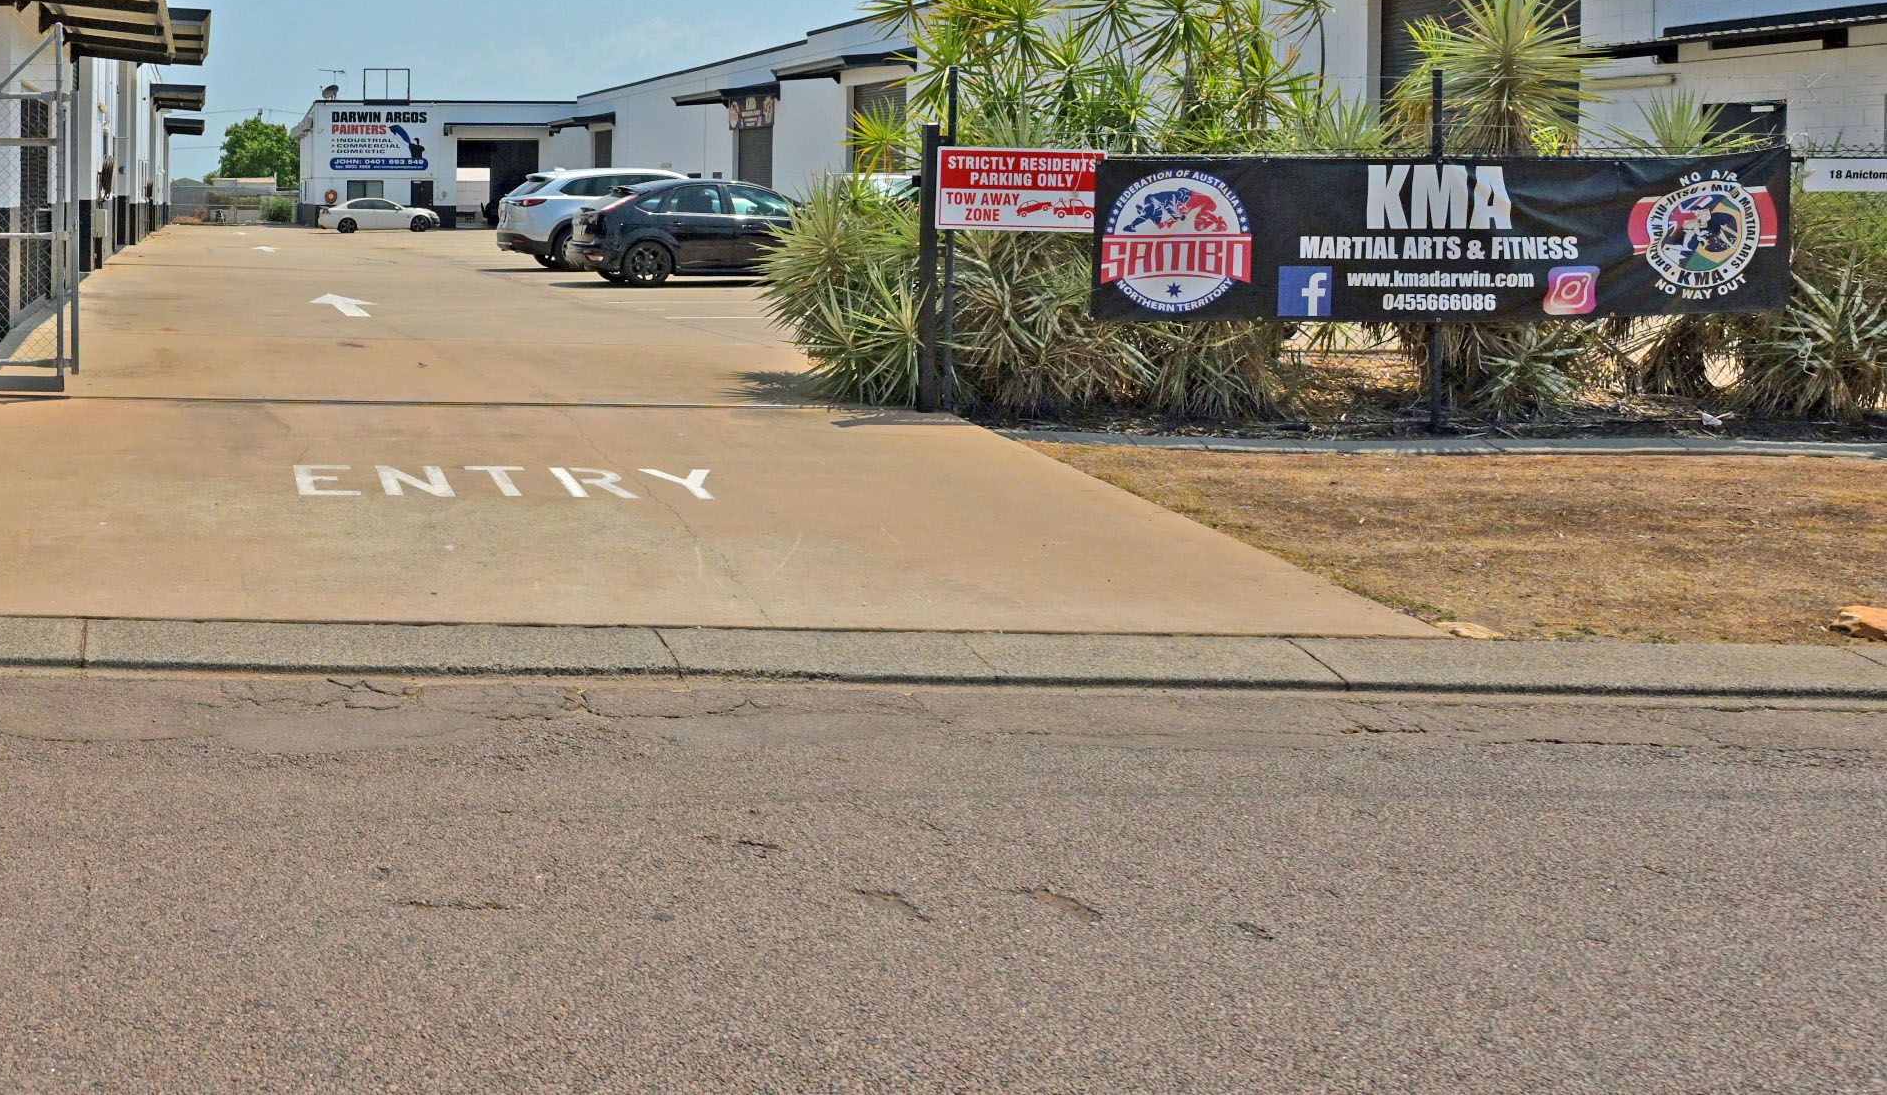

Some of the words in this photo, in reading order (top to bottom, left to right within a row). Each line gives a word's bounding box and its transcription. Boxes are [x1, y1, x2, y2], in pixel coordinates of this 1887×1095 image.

[331, 111, 381, 123] DARWIN
[385, 111, 428, 123] ARGOS
[331, 124, 387, 135] PAINTERS
[947, 155, 1015, 171] STRICTLY
[1019, 157, 1096, 173] RESIDENTS
[970, 172, 1032, 187] PARKING
[1037, 173, 1074, 188] ONLY
[1679, 171, 1702, 187] NO
[1711, 169, 1738, 182] AIR
[1829, 170, 1843, 180] 18
[1845, 169, 1887, 180] Anictom
[1116, 170, 1173, 208] FEDERATION
[1175, 169, 1190, 178] OF
[1192, 170, 1240, 207] AUSTRALIA
[1366, 164, 1512, 230] KMA
[1710, 184, 1741, 200] MIXD
[946, 192, 977, 205] TOW
[980, 193, 1020, 206] AWAY
[1650, 186, 1699, 222] JIU-JITSU
[965, 208, 1000, 221] ZONE
[1738, 196, 1756, 243] MARTIAL
[1299, 236, 1399, 260] MARTIAL
[1402, 236, 1462, 260] ARTS
[1466, 239, 1486, 260] &
[1490, 236, 1579, 260] FITNESS
[1730, 243, 1752, 269] ARTS
[1100, 240, 1252, 284] SAMBO
[1346, 270, 1535, 288] www.kmadarwin.com
[1654, 279, 1677, 295] NO
[1682, 288, 1713, 300] WAY
[1717, 273, 1747, 295] OUT
[1676, 270, 1725, 286] KMA
[1116, 279, 1175, 312] NORTHERN
[1177, 277, 1233, 312] TERRITORY
[1382, 293, 1496, 311] 0455666086
[292, 464, 715, 500] ENTRY
